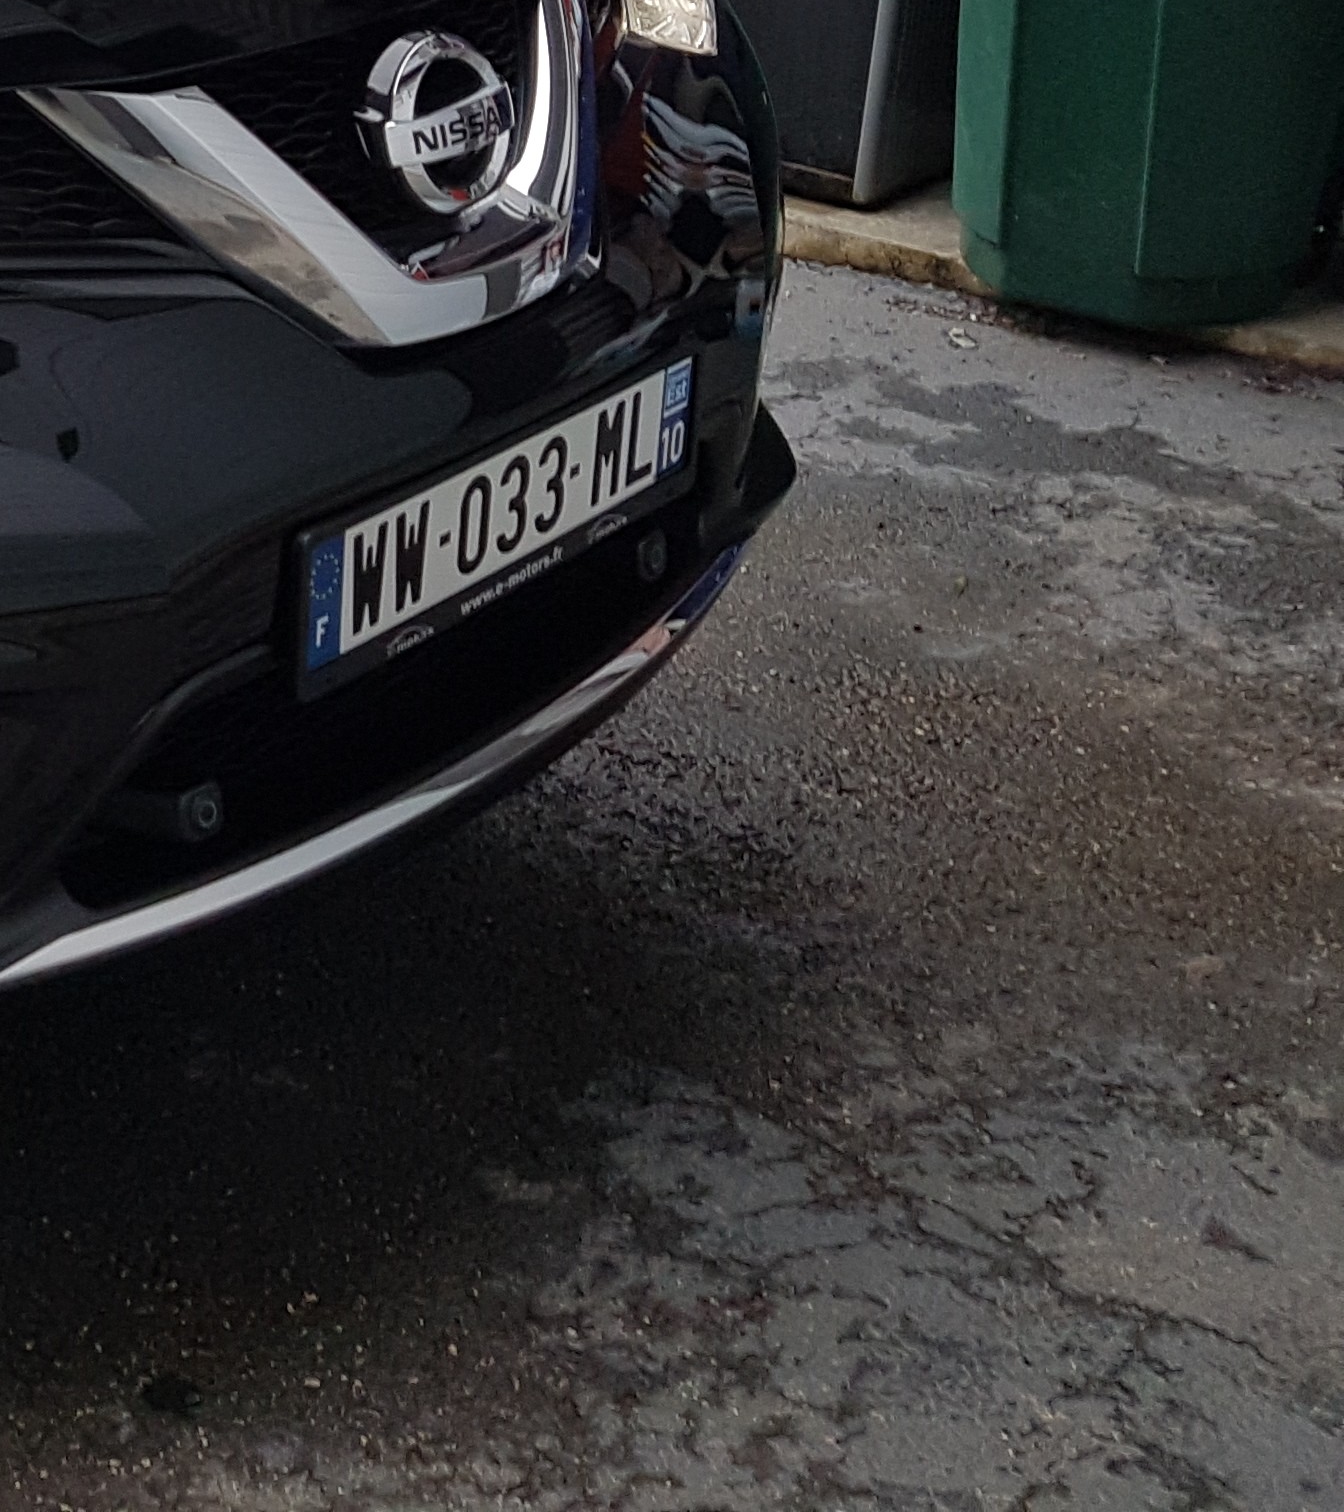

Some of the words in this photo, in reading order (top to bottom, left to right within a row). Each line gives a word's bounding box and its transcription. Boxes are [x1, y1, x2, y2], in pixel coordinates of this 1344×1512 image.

[413, 106, 502, 154] NISSA
[314, 614, 330, 648] F
[352, 390, 653, 637] WW-033-ML
[661, 419, 686, 470] 10
